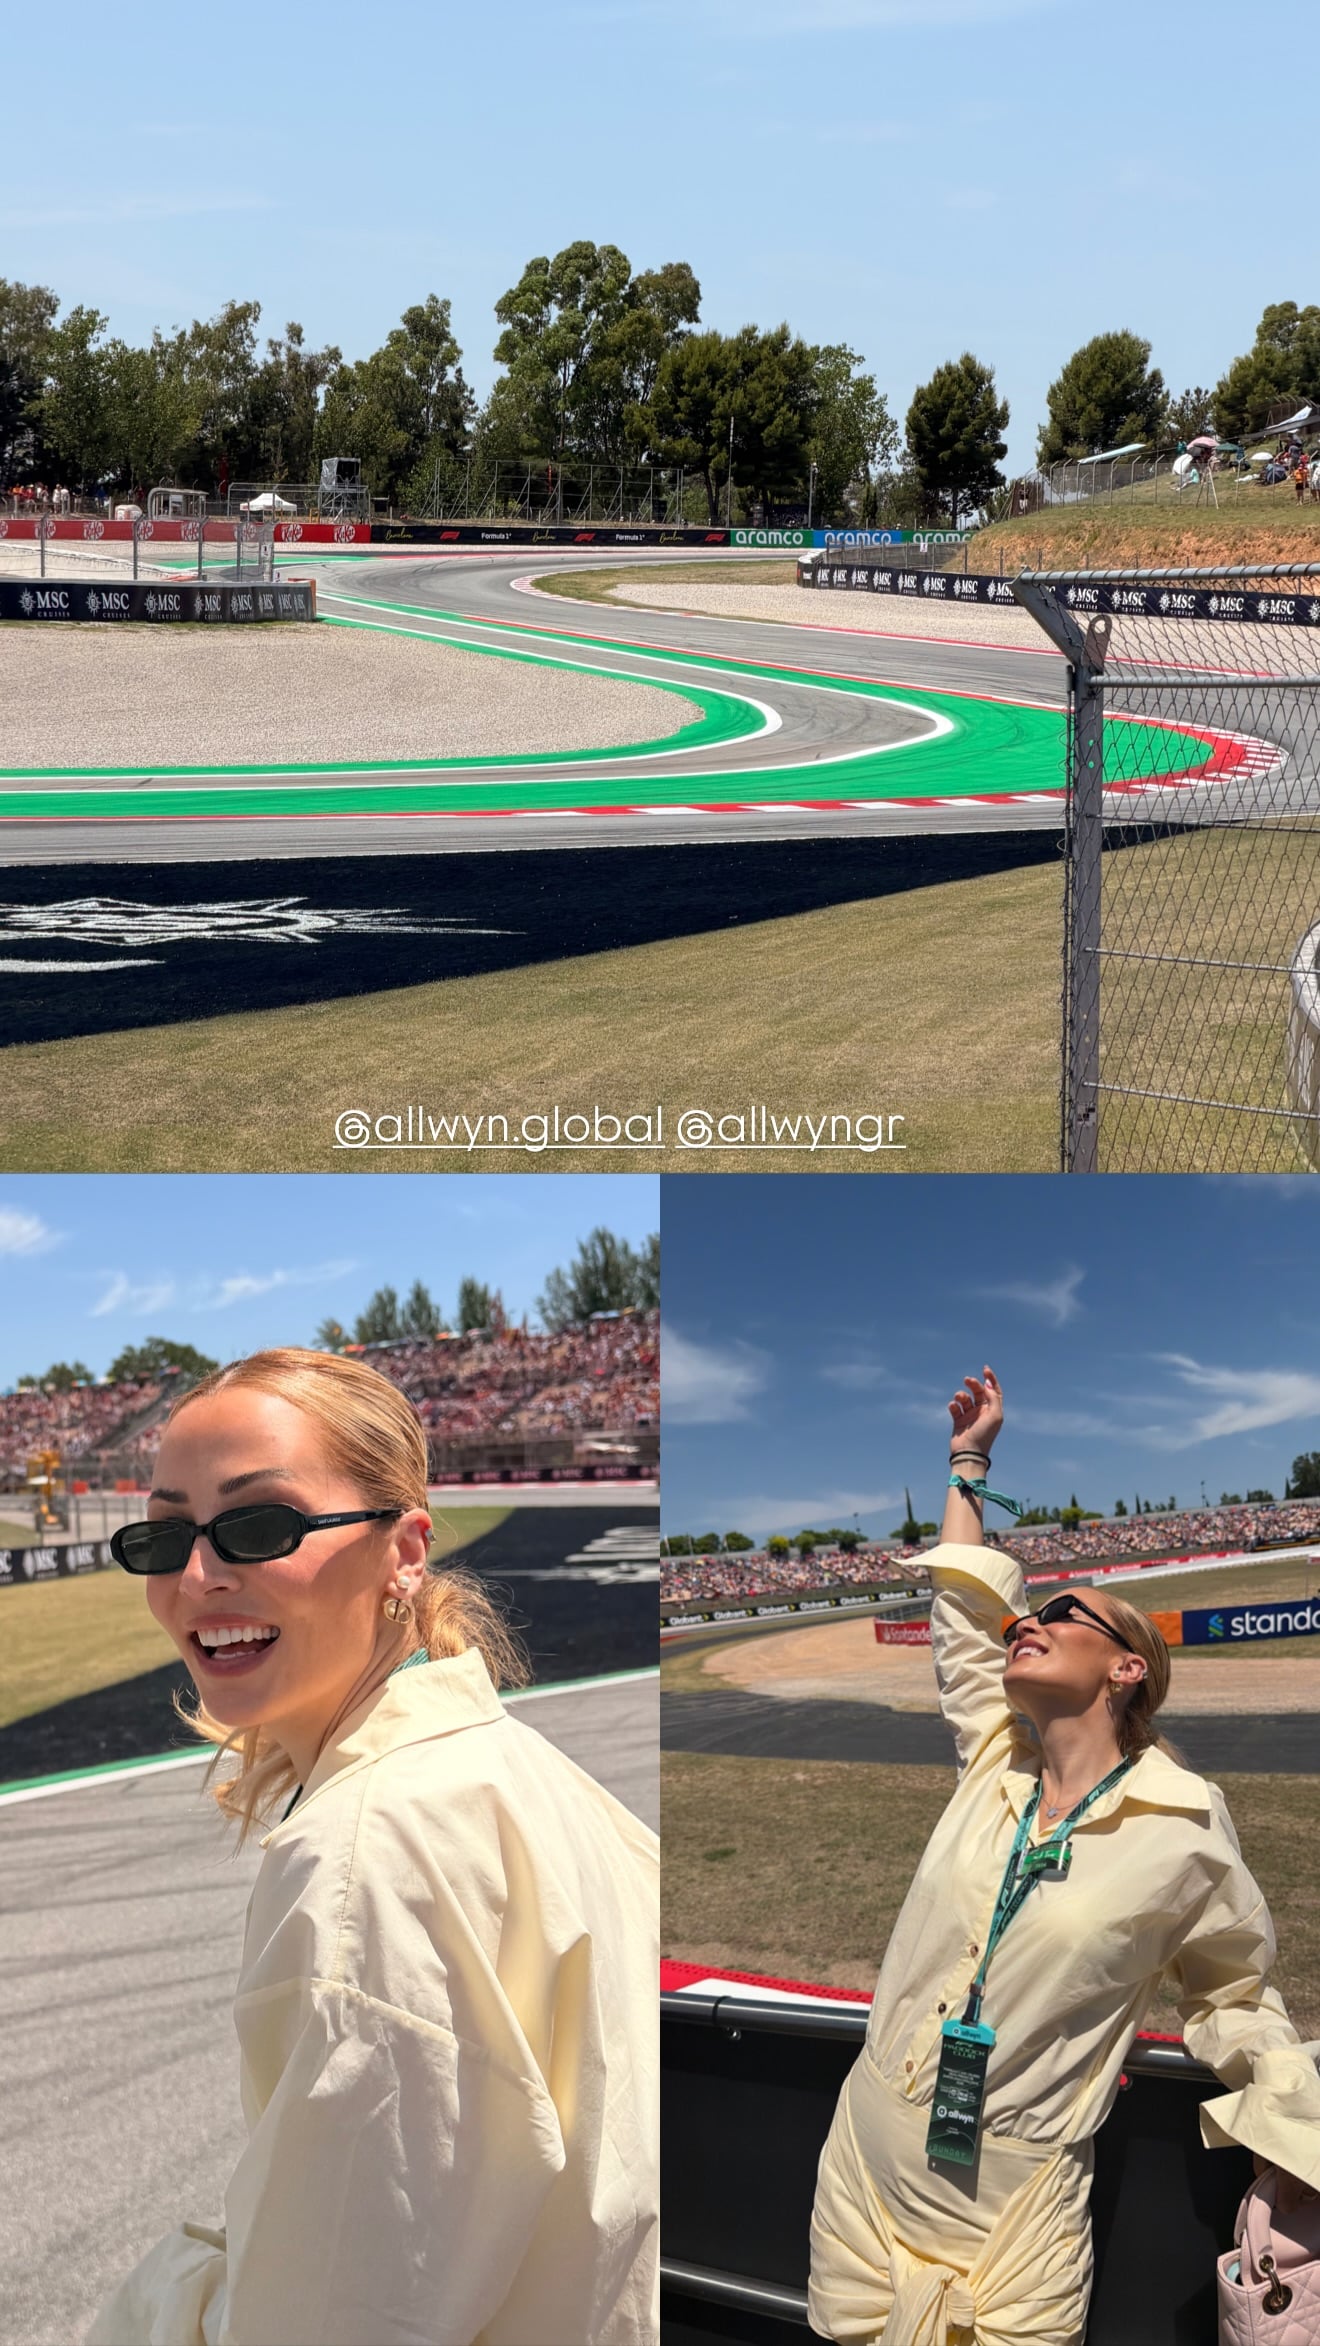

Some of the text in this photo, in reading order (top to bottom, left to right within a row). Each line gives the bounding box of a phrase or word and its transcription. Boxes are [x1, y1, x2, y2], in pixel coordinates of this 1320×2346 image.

[481, 532, 505, 540] Formula
[615, 533, 640, 541] Formula
[735, 530, 803, 546] aramco
[824, 531, 892, 546] aramco
[857, 570, 869, 584] MSC
[879, 572, 892, 586] MSC
[904, 574, 918, 589] MSC
[930, 577, 947, 592] MSC
[961, 580, 979, 594] MSC
[36, 591, 69, 609] MSC
[101, 593, 130, 610] MSC
[157, 594, 181, 610] MSC
[204, 595, 221, 611] MSC
[238, 594, 253, 610] MSC
[1077, 588, 1099, 603] MSC
[1122, 591, 1147, 606] MSC
[1171, 594, 1196, 609] MSC
[1220, 597, 1245, 612] MSC
[1270, 600, 1296, 615] MSC
[840, 1594, 870, 1606] Globant
[879, 1590, 908, 1600] Globant
[757, 1604, 789, 1616] Globant
[799, 1599, 830, 1611] Globant
[669, 1613, 704, 1626] Globant
[714, 1608, 747, 1620] Globant
[890, 1626, 932, 1642] Santande
[948, 2109, 975, 2124] allwyn
